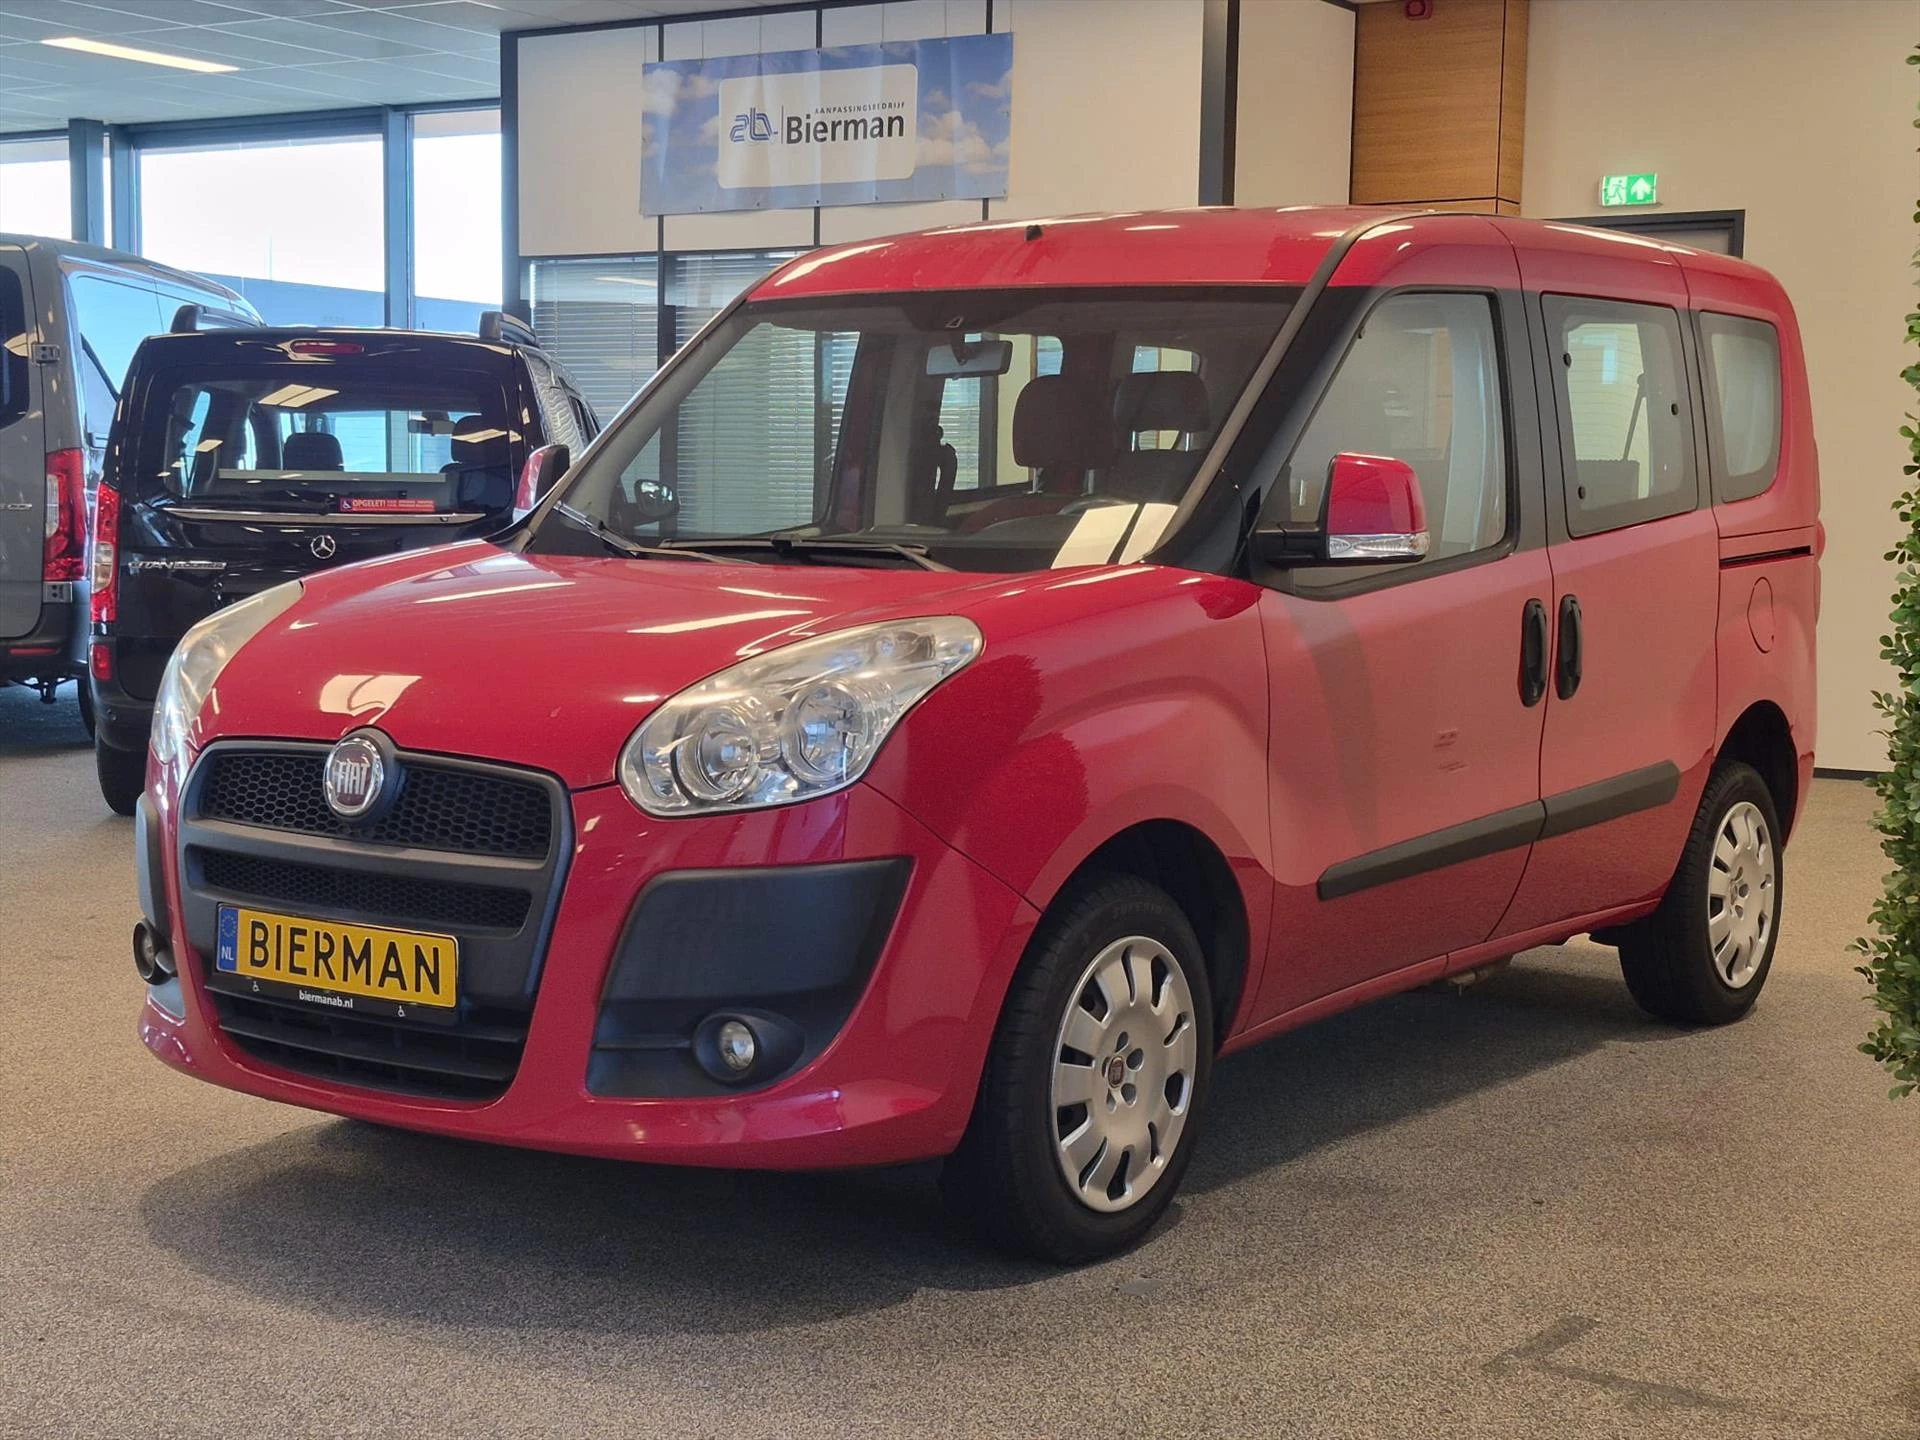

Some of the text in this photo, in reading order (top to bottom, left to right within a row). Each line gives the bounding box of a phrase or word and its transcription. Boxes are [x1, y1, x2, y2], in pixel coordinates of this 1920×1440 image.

[786, 114, 904, 144] Bierman
[336, 760, 371, 795] FIAT
[221, 920, 440, 995] NL BIERMAN
[299, 990, 354, 1009] biermanab.nl
